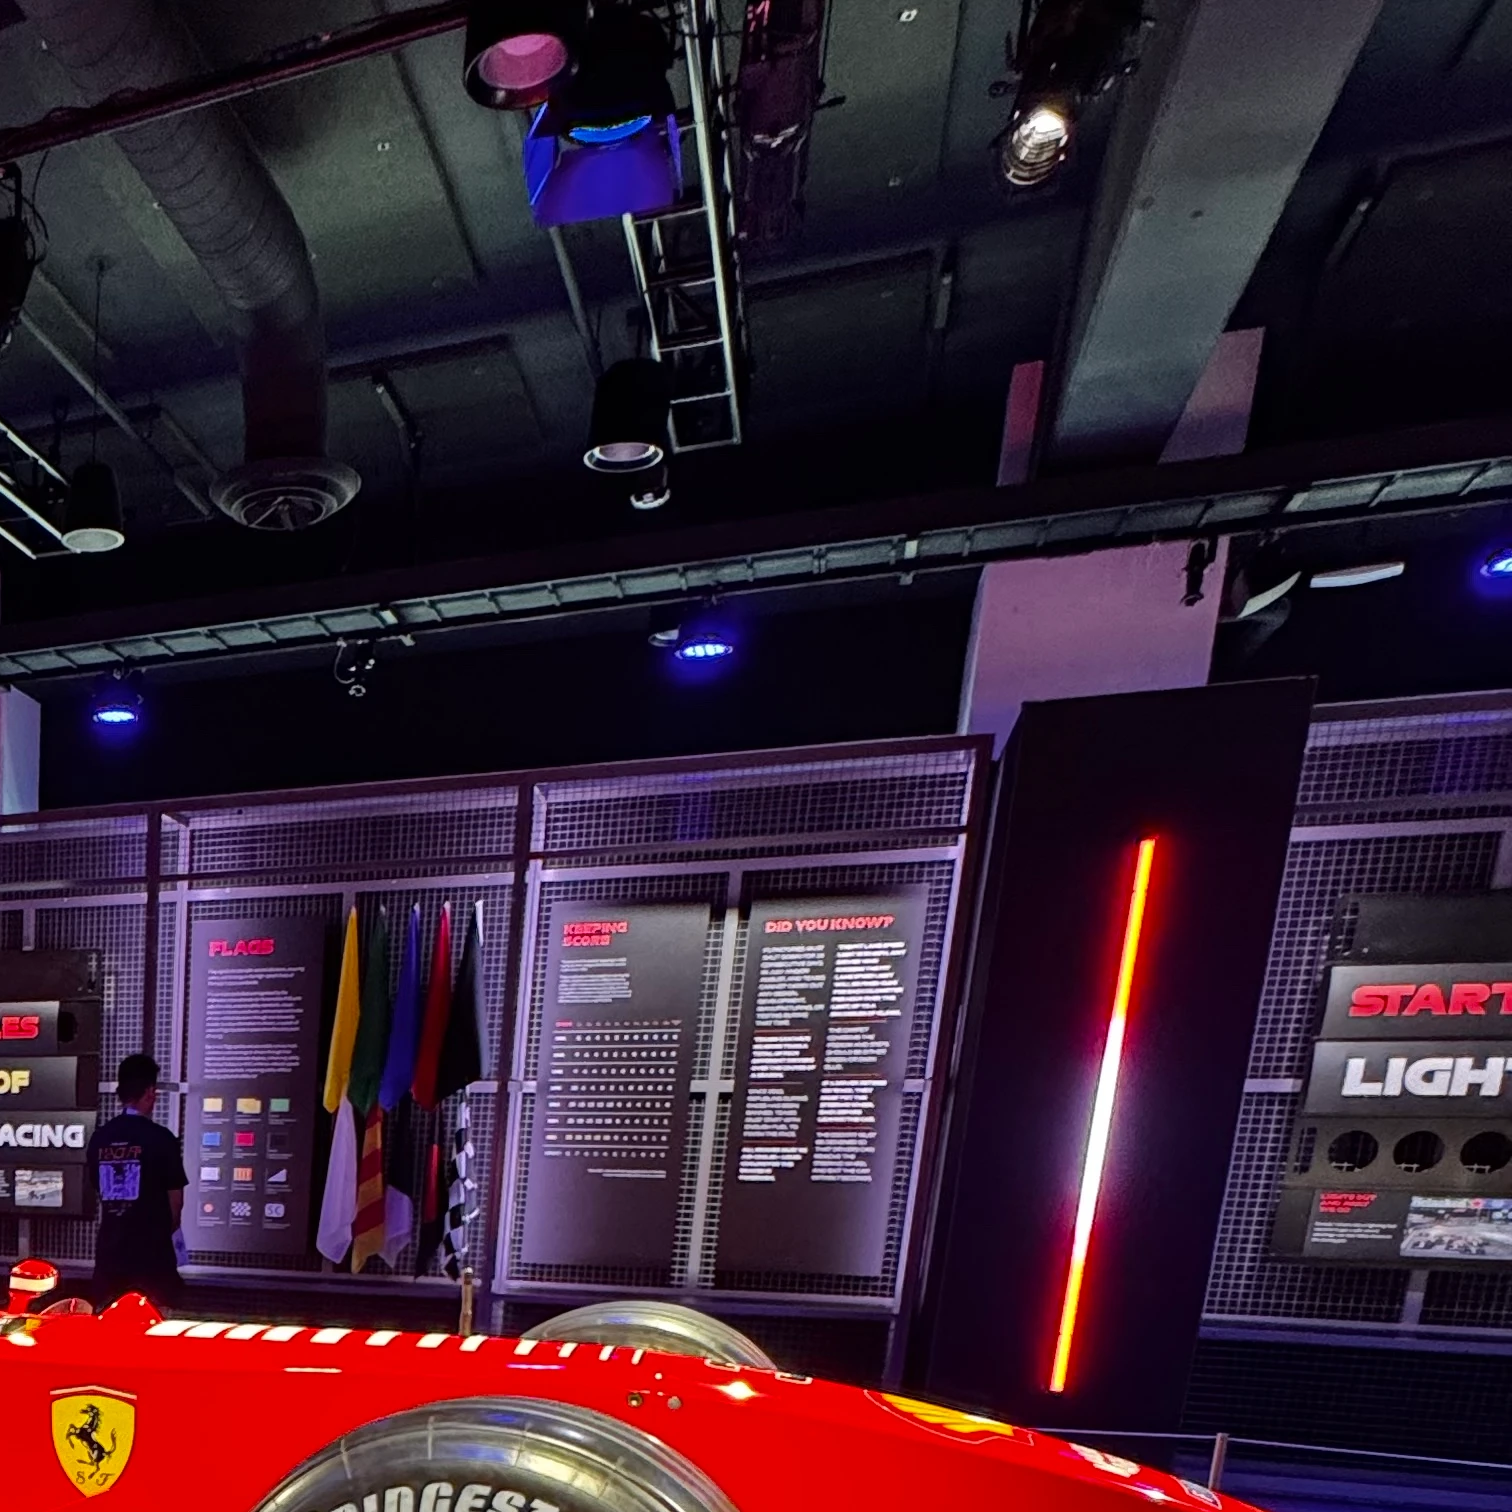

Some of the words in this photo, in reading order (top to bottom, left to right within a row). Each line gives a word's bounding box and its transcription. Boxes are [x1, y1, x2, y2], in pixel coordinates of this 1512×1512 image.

[765, 920, 793, 934] DID
[795, 918, 829, 934] YOU
[208, 939, 275, 957] FLAGS
[1348, 982, 1512, 1017] START
